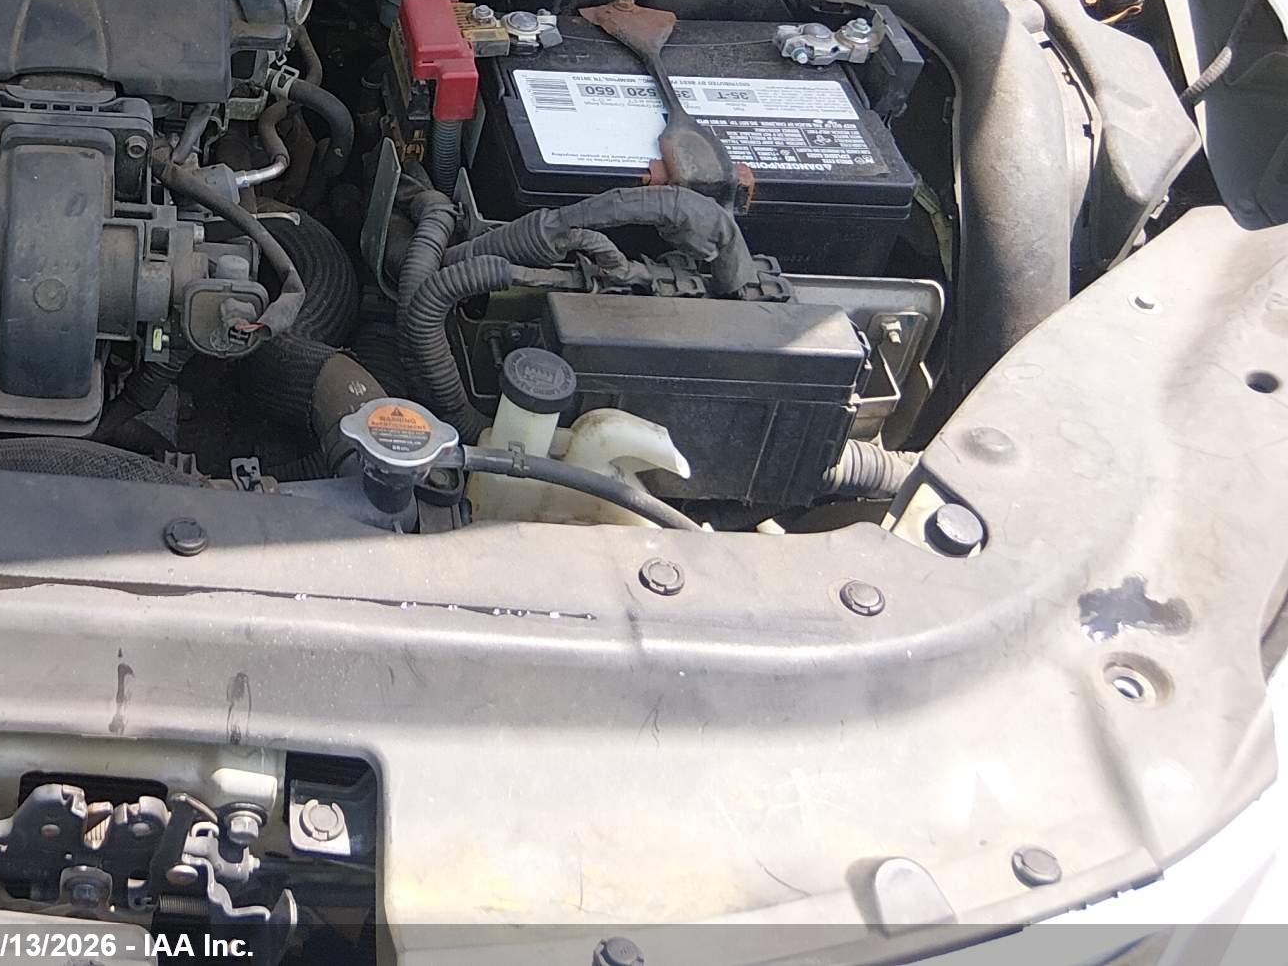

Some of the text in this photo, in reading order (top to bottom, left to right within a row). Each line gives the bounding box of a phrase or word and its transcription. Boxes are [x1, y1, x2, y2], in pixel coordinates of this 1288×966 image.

[585, 86, 615, 96] 650
[626, 87, 657, 97] 520
[717, 91, 749, 100] 35-T
